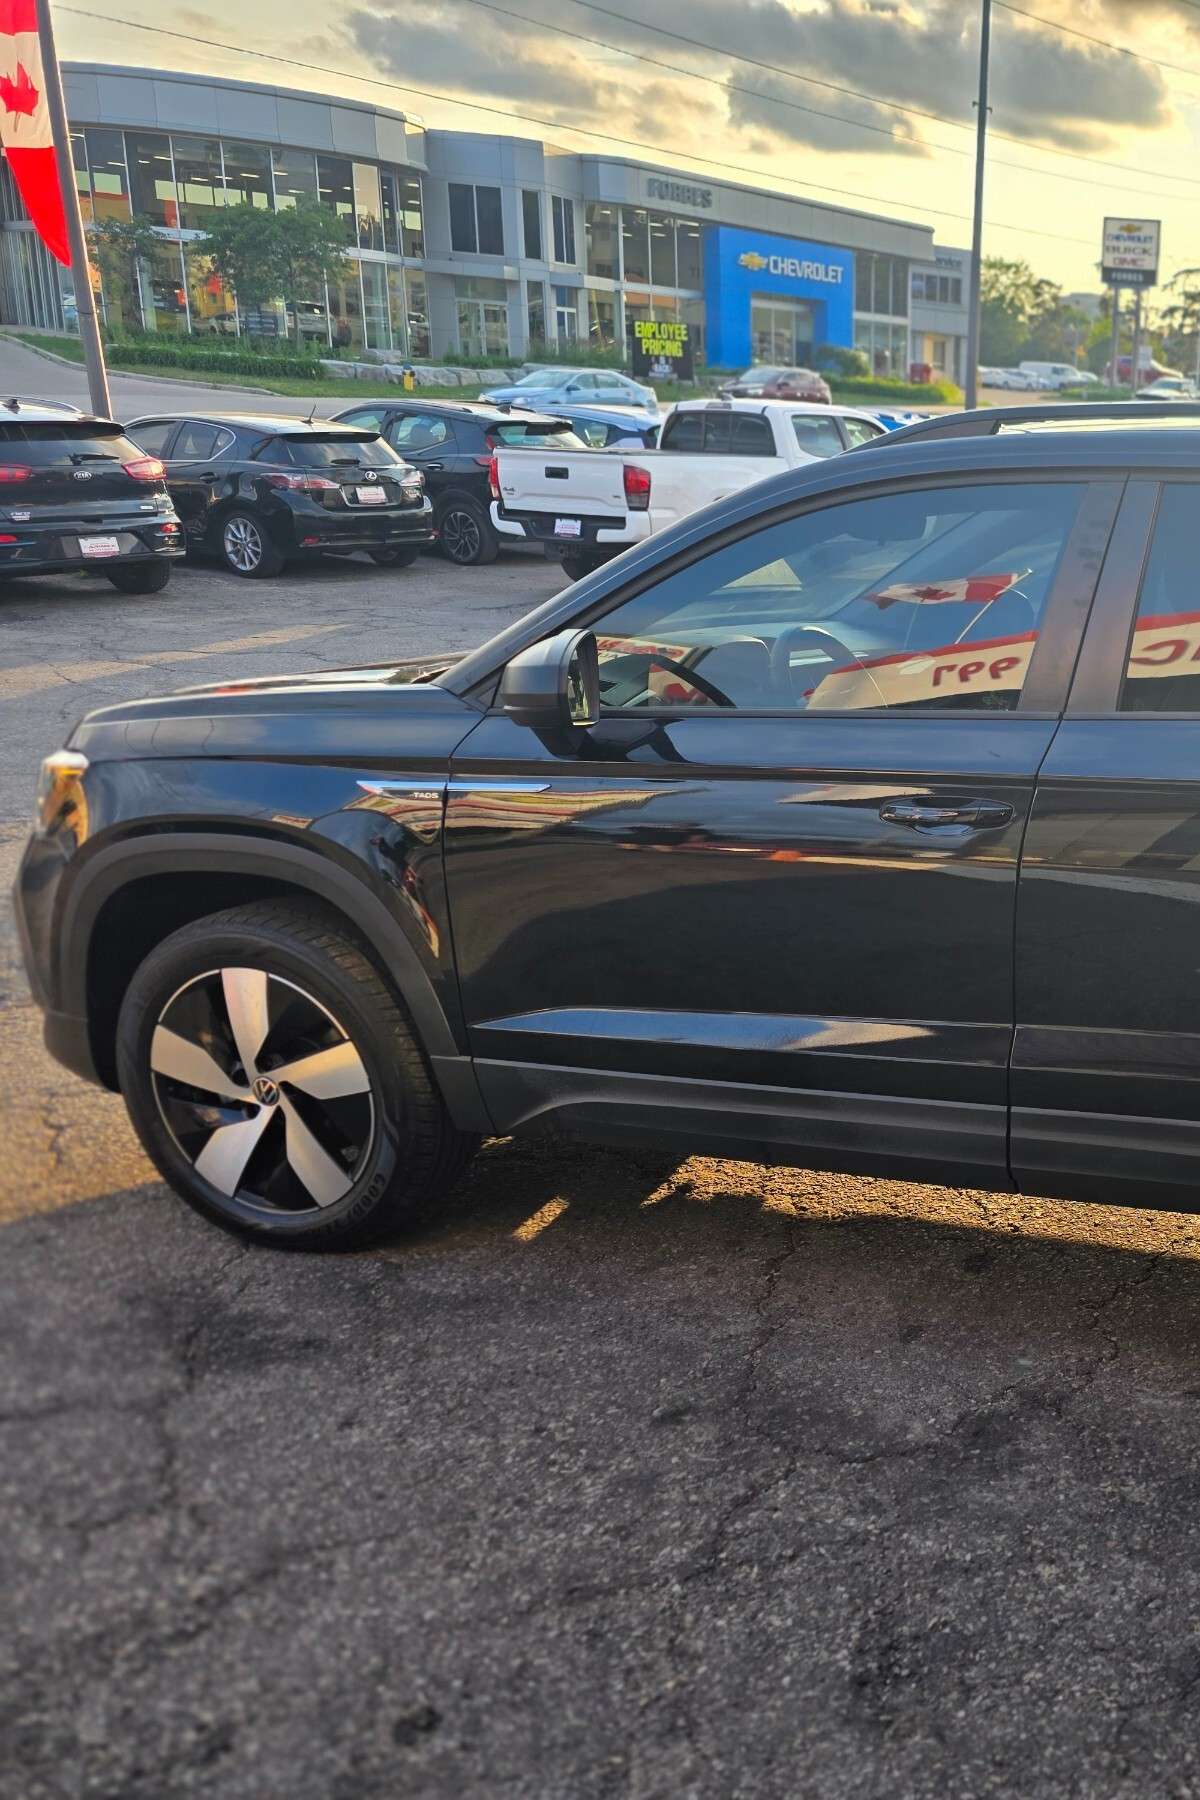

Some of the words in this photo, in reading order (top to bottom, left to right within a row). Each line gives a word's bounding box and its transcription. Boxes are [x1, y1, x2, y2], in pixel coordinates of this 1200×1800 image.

[647, 178, 712, 208] FORBES
[769, 256, 844, 284] CHEVROLET
[634, 321, 689, 341] EMPLOYEE
[642, 339, 684, 357] PRICING
[413, 791, 439, 799] TAOS
